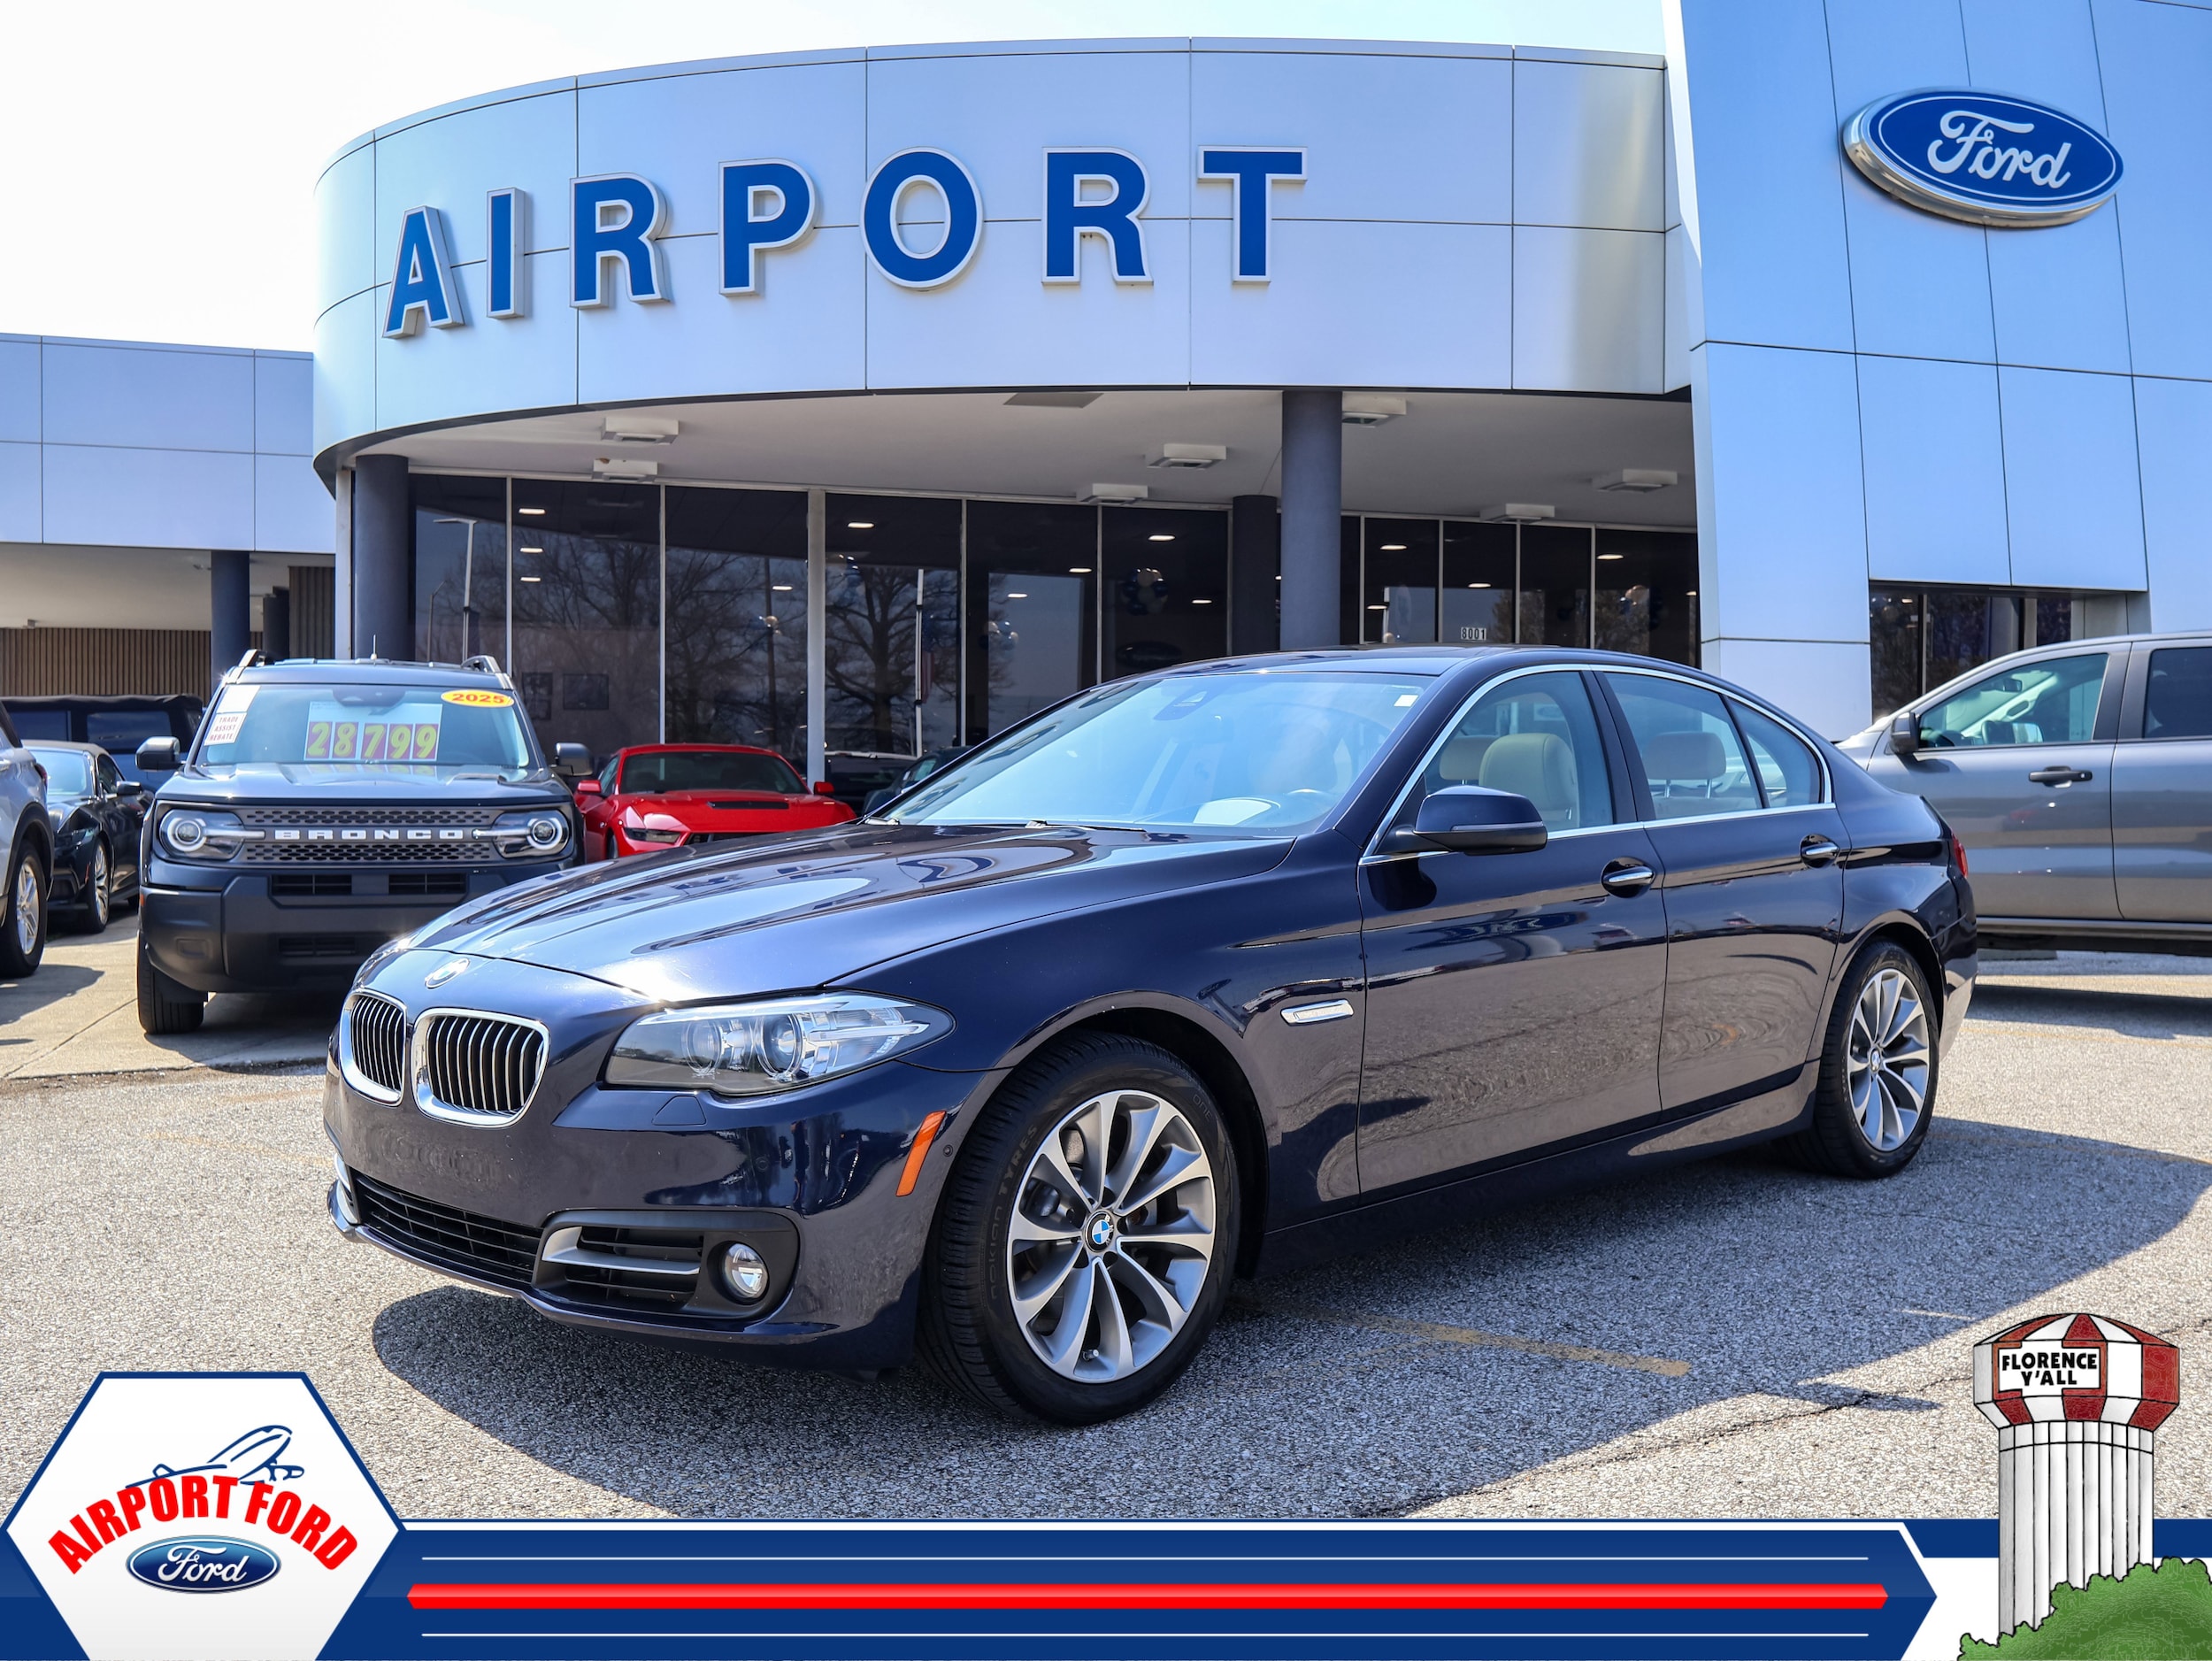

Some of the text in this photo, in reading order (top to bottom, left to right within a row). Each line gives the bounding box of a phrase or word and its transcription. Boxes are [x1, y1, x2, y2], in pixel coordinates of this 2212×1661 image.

[1927, 111, 2072, 188] Ford
[381, 145, 1307, 339] AIRPORT
[1462, 627, 1485, 640] 8001
[451, 692, 505, 704] 2025
[210, 733, 234, 742] REBATE
[307, 721, 437, 758] 28799
[274, 829, 464, 840] BRONCO
[998, 1125, 1037, 1196] TYRES
